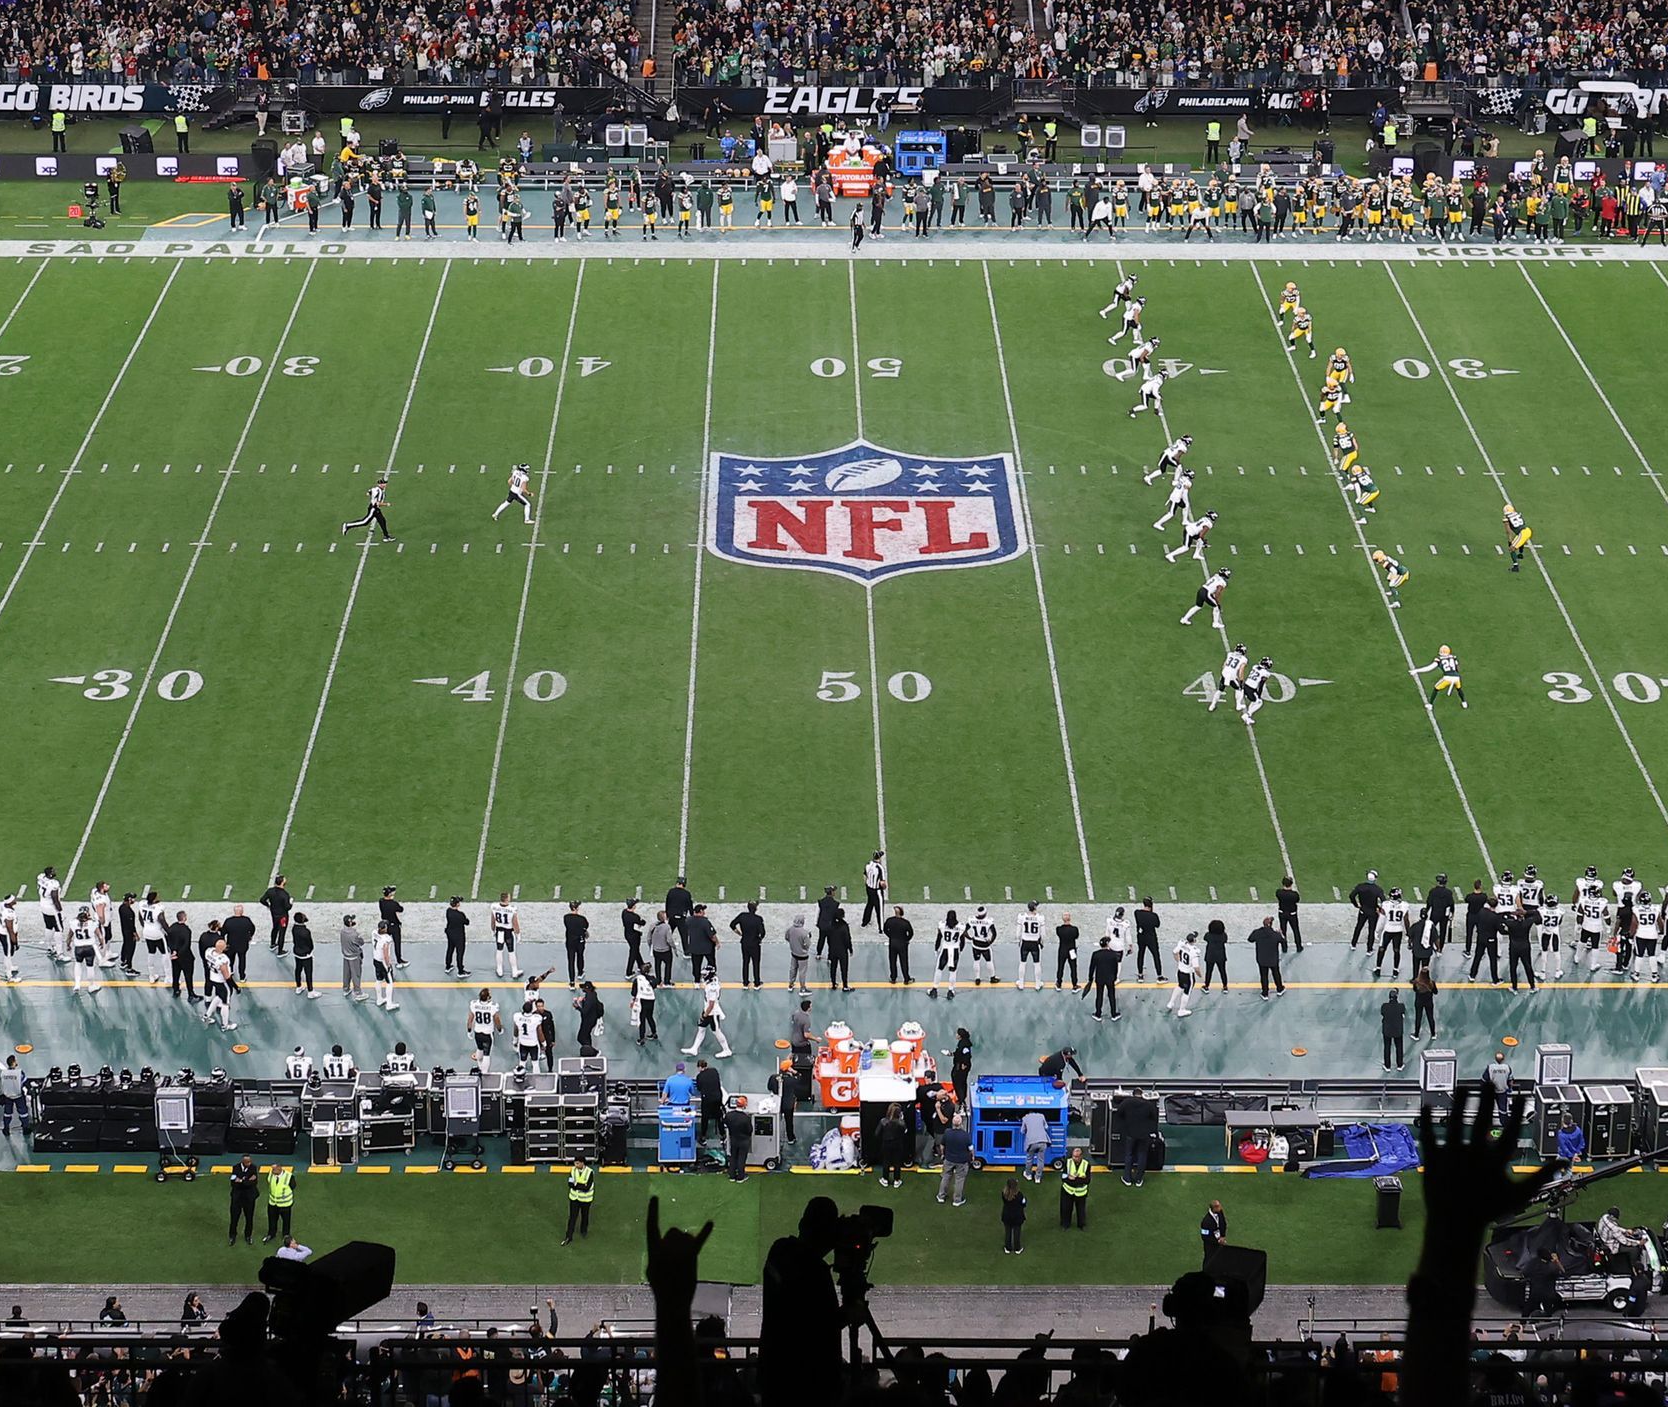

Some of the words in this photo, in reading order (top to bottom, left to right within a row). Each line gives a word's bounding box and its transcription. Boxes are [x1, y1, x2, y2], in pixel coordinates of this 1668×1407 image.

[49, 84, 145, 111] BIRDS
[479, 90, 557, 108] EGLES
[1178, 97, 1250, 107] PHILADELPHIA
[1450, 197, 1459, 205] 74
[26, 239, 150, 256] SÃO
[163, 242, 348, 256] PAULO
[1415, 246, 1606, 258] KICKOFF
[225, 354, 321, 377] 30
[516, 355, 613, 377] 40
[810, 356, 903, 379] 50
[1393, 357, 1488, 380] 30
[745, 498, 991, 563] NFL
[1226, 656, 1239, 668] 33
[1442, 659, 1456, 672] 24
[82, 667, 205, 702] 30
[448, 667, 569, 702] 40
[815, 669, 934, 703] 50
[1542, 670, 1662, 705] 30
[1498, 893, 1513, 906] 53
[1522, 888, 1537, 900] 27
[142, 909, 153, 923] 74
[495, 912, 509, 925] 81
[1388, 910, 1404, 922] 19
[1583, 905, 1600, 919] 55
[1543, 915, 1559, 927] 23
[1639, 913, 1656, 926] 59
[75, 929, 90, 940] 61
[973, 926, 987, 938] 14
[1023, 922, 1038, 934] 16
[1112, 928, 1120, 938] 4
[944, 931, 959, 943] 84
[1179, 950, 1190, 965] 19
[475, 1011, 492, 1025] 88
[521, 1023, 529, 1036] 1
[293, 1064, 302, 1079] 6
[329, 1063, 344, 1077] 11
[830, 1081, 853, 1102] G
